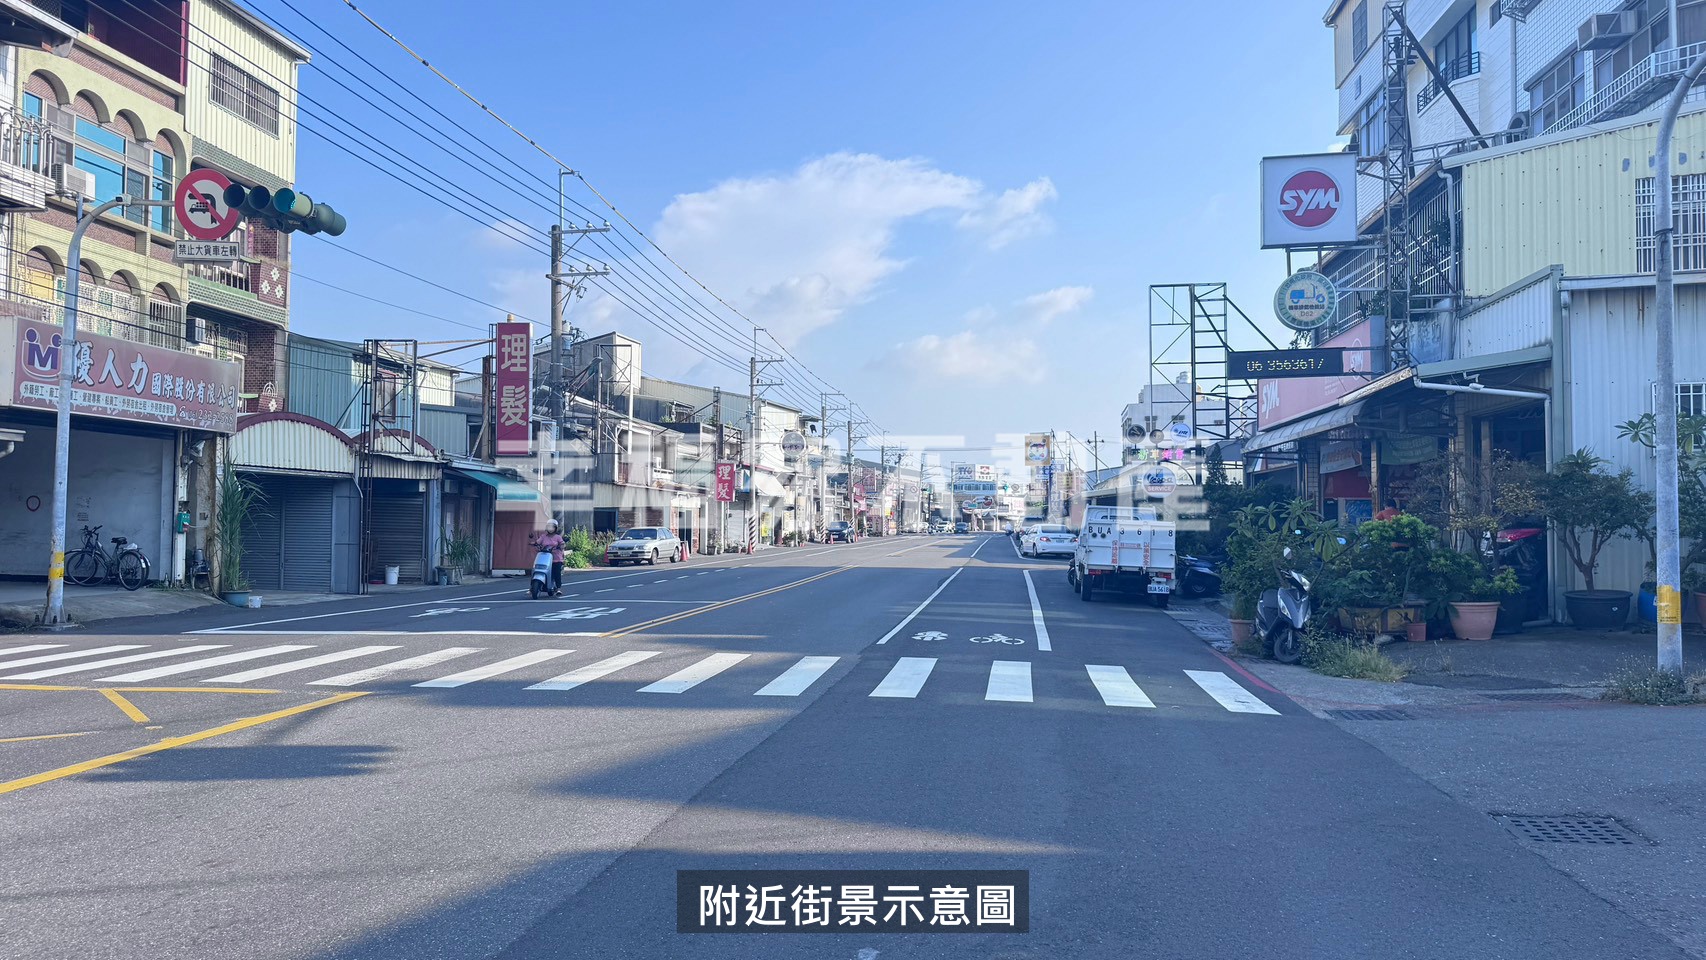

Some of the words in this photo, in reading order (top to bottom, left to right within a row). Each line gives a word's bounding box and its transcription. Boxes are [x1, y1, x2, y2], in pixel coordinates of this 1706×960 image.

[1280, 188, 1339, 216] SYM
[178, 243, 238, 257] 禁止大貨車左轉
[151, 372, 236, 408] 國際股份有限公司
[501, 333, 528, 427] 理髮
[1262, 379, 1280, 419] SYM
[718, 465, 731, 500] 理髮
[1088, 526, 1112, 535] BUA
